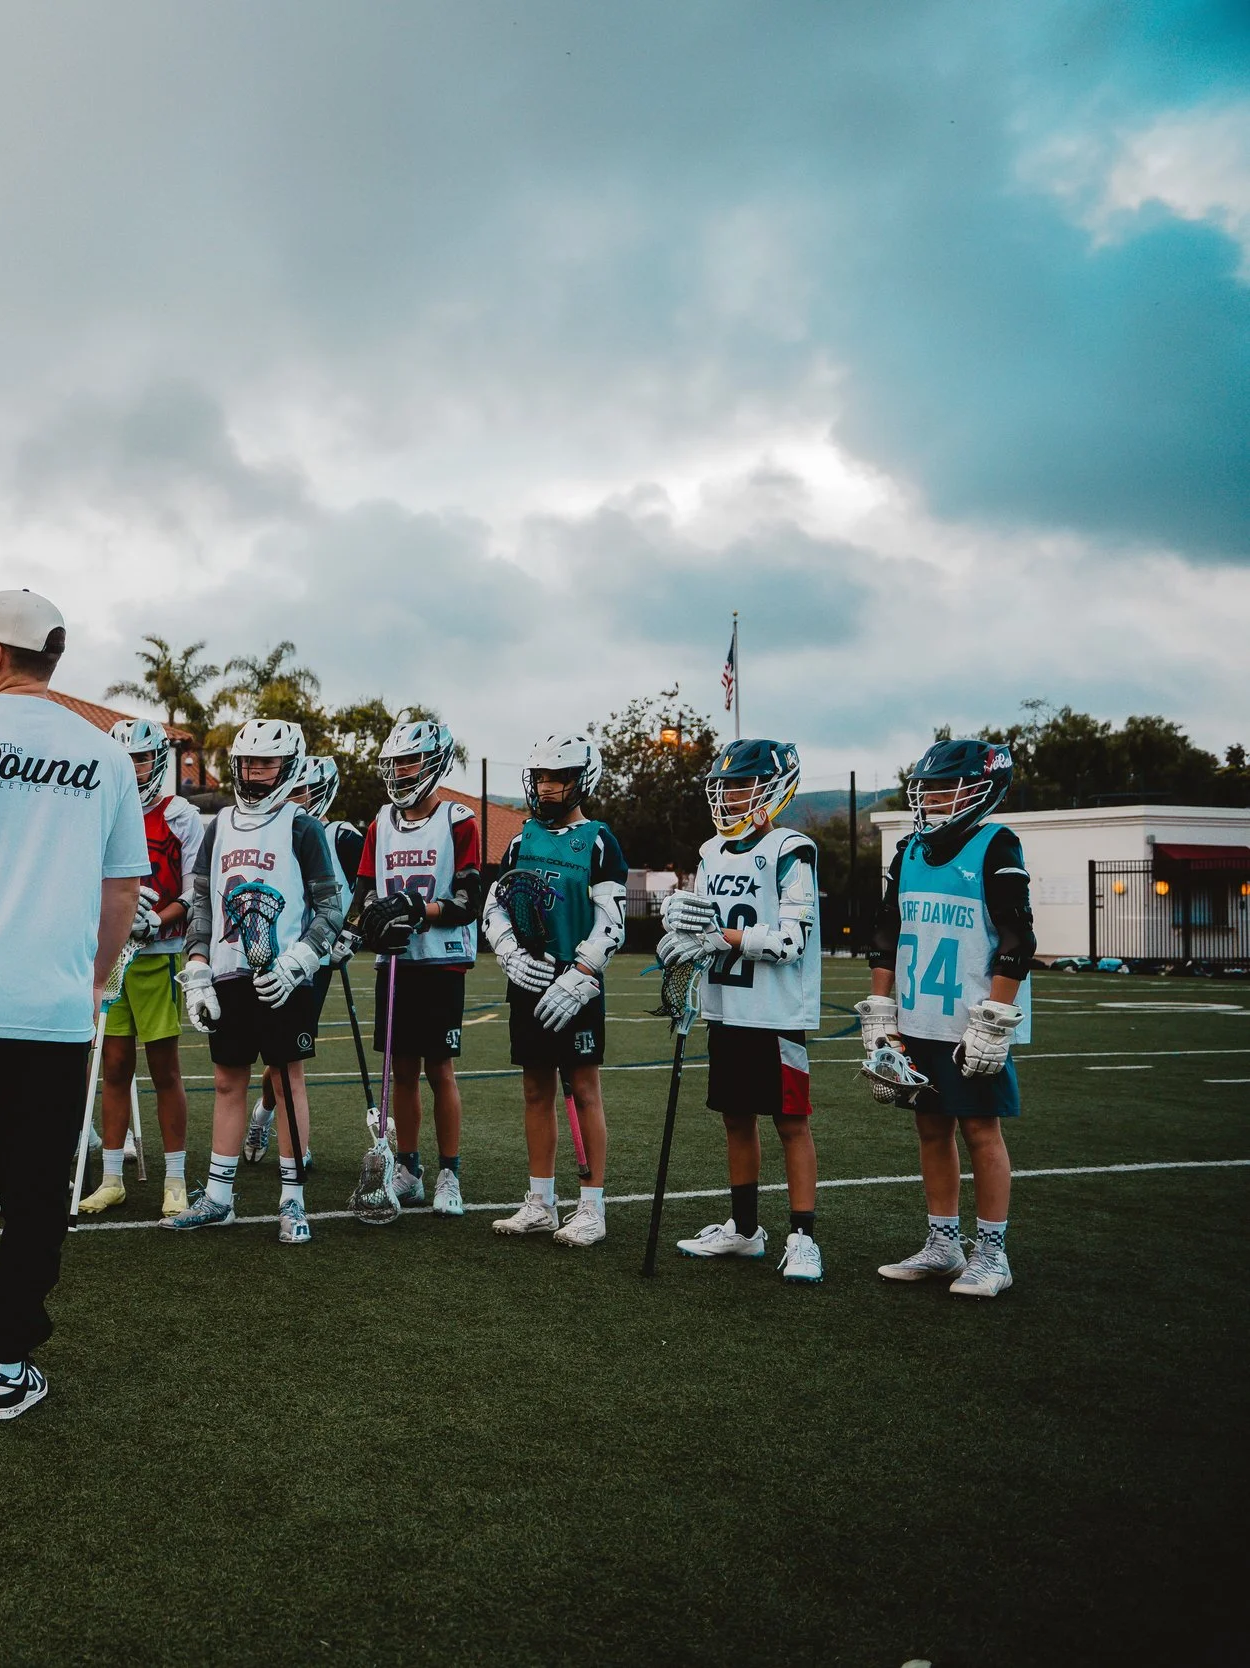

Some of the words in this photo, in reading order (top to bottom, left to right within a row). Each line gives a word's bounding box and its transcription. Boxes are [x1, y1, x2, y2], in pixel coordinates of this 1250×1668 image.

[0, 743, 23, 755] The
[53, 786, 91, 799] CLUB
[221, 849, 275, 874] REBELS
[546, 857, 589, 872] COUNTY
[707, 874, 750, 896] WCS
[921, 902, 975, 929] DAWGS
[899, 933, 963, 1016] 34
